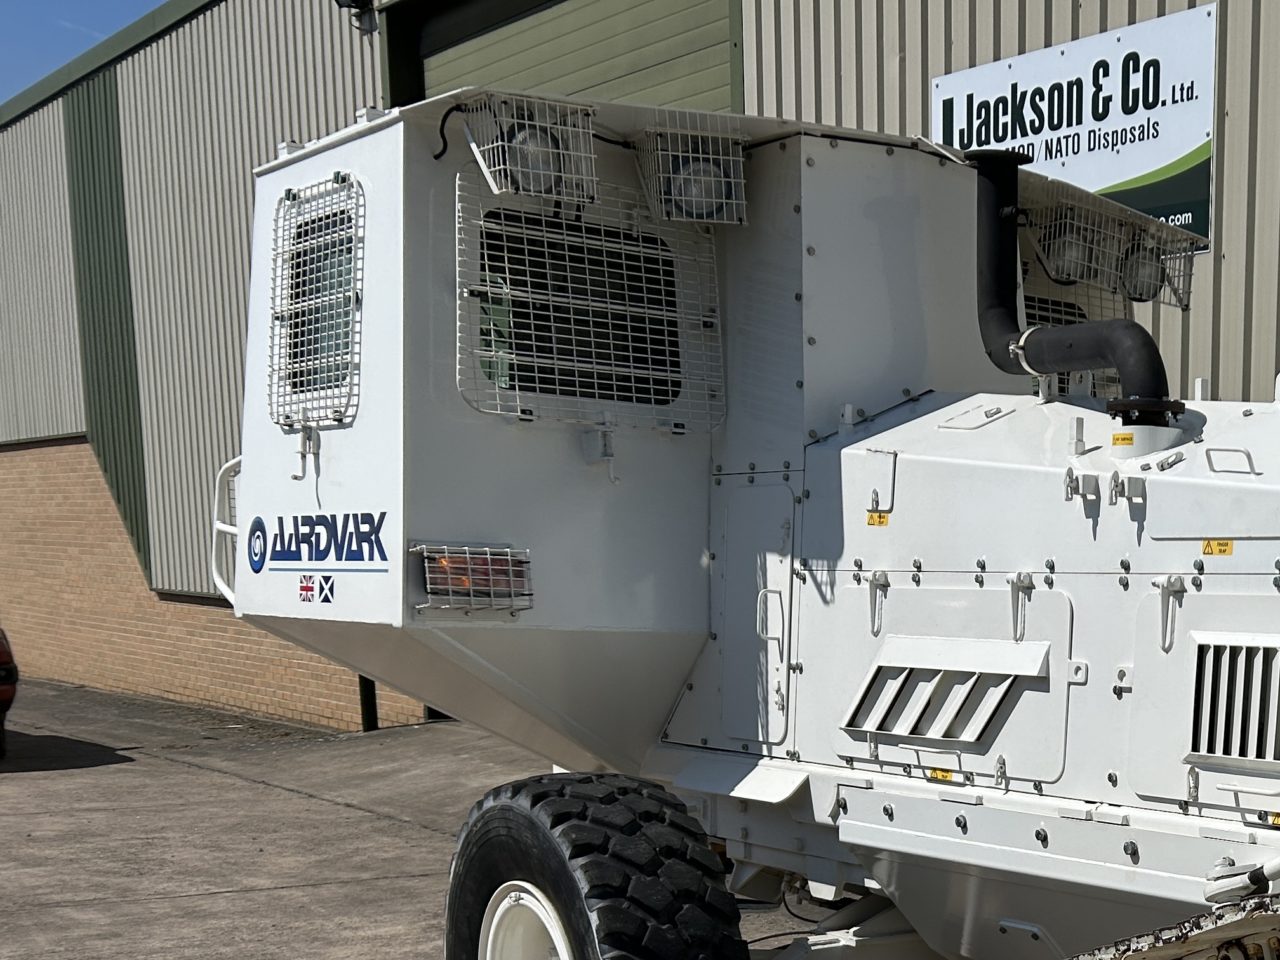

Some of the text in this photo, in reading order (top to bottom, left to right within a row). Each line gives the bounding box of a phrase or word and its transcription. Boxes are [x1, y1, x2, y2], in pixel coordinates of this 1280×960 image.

[958, 77, 1084, 151] Jackson
[1091, 59, 1113, 122] &
[1120, 51, 1166, 116] Co.
[1171, 80, 1199, 104] Ltd.
[1087, 118, 1160, 152] Disposals
[269, 512, 389, 562] AARDVARK
